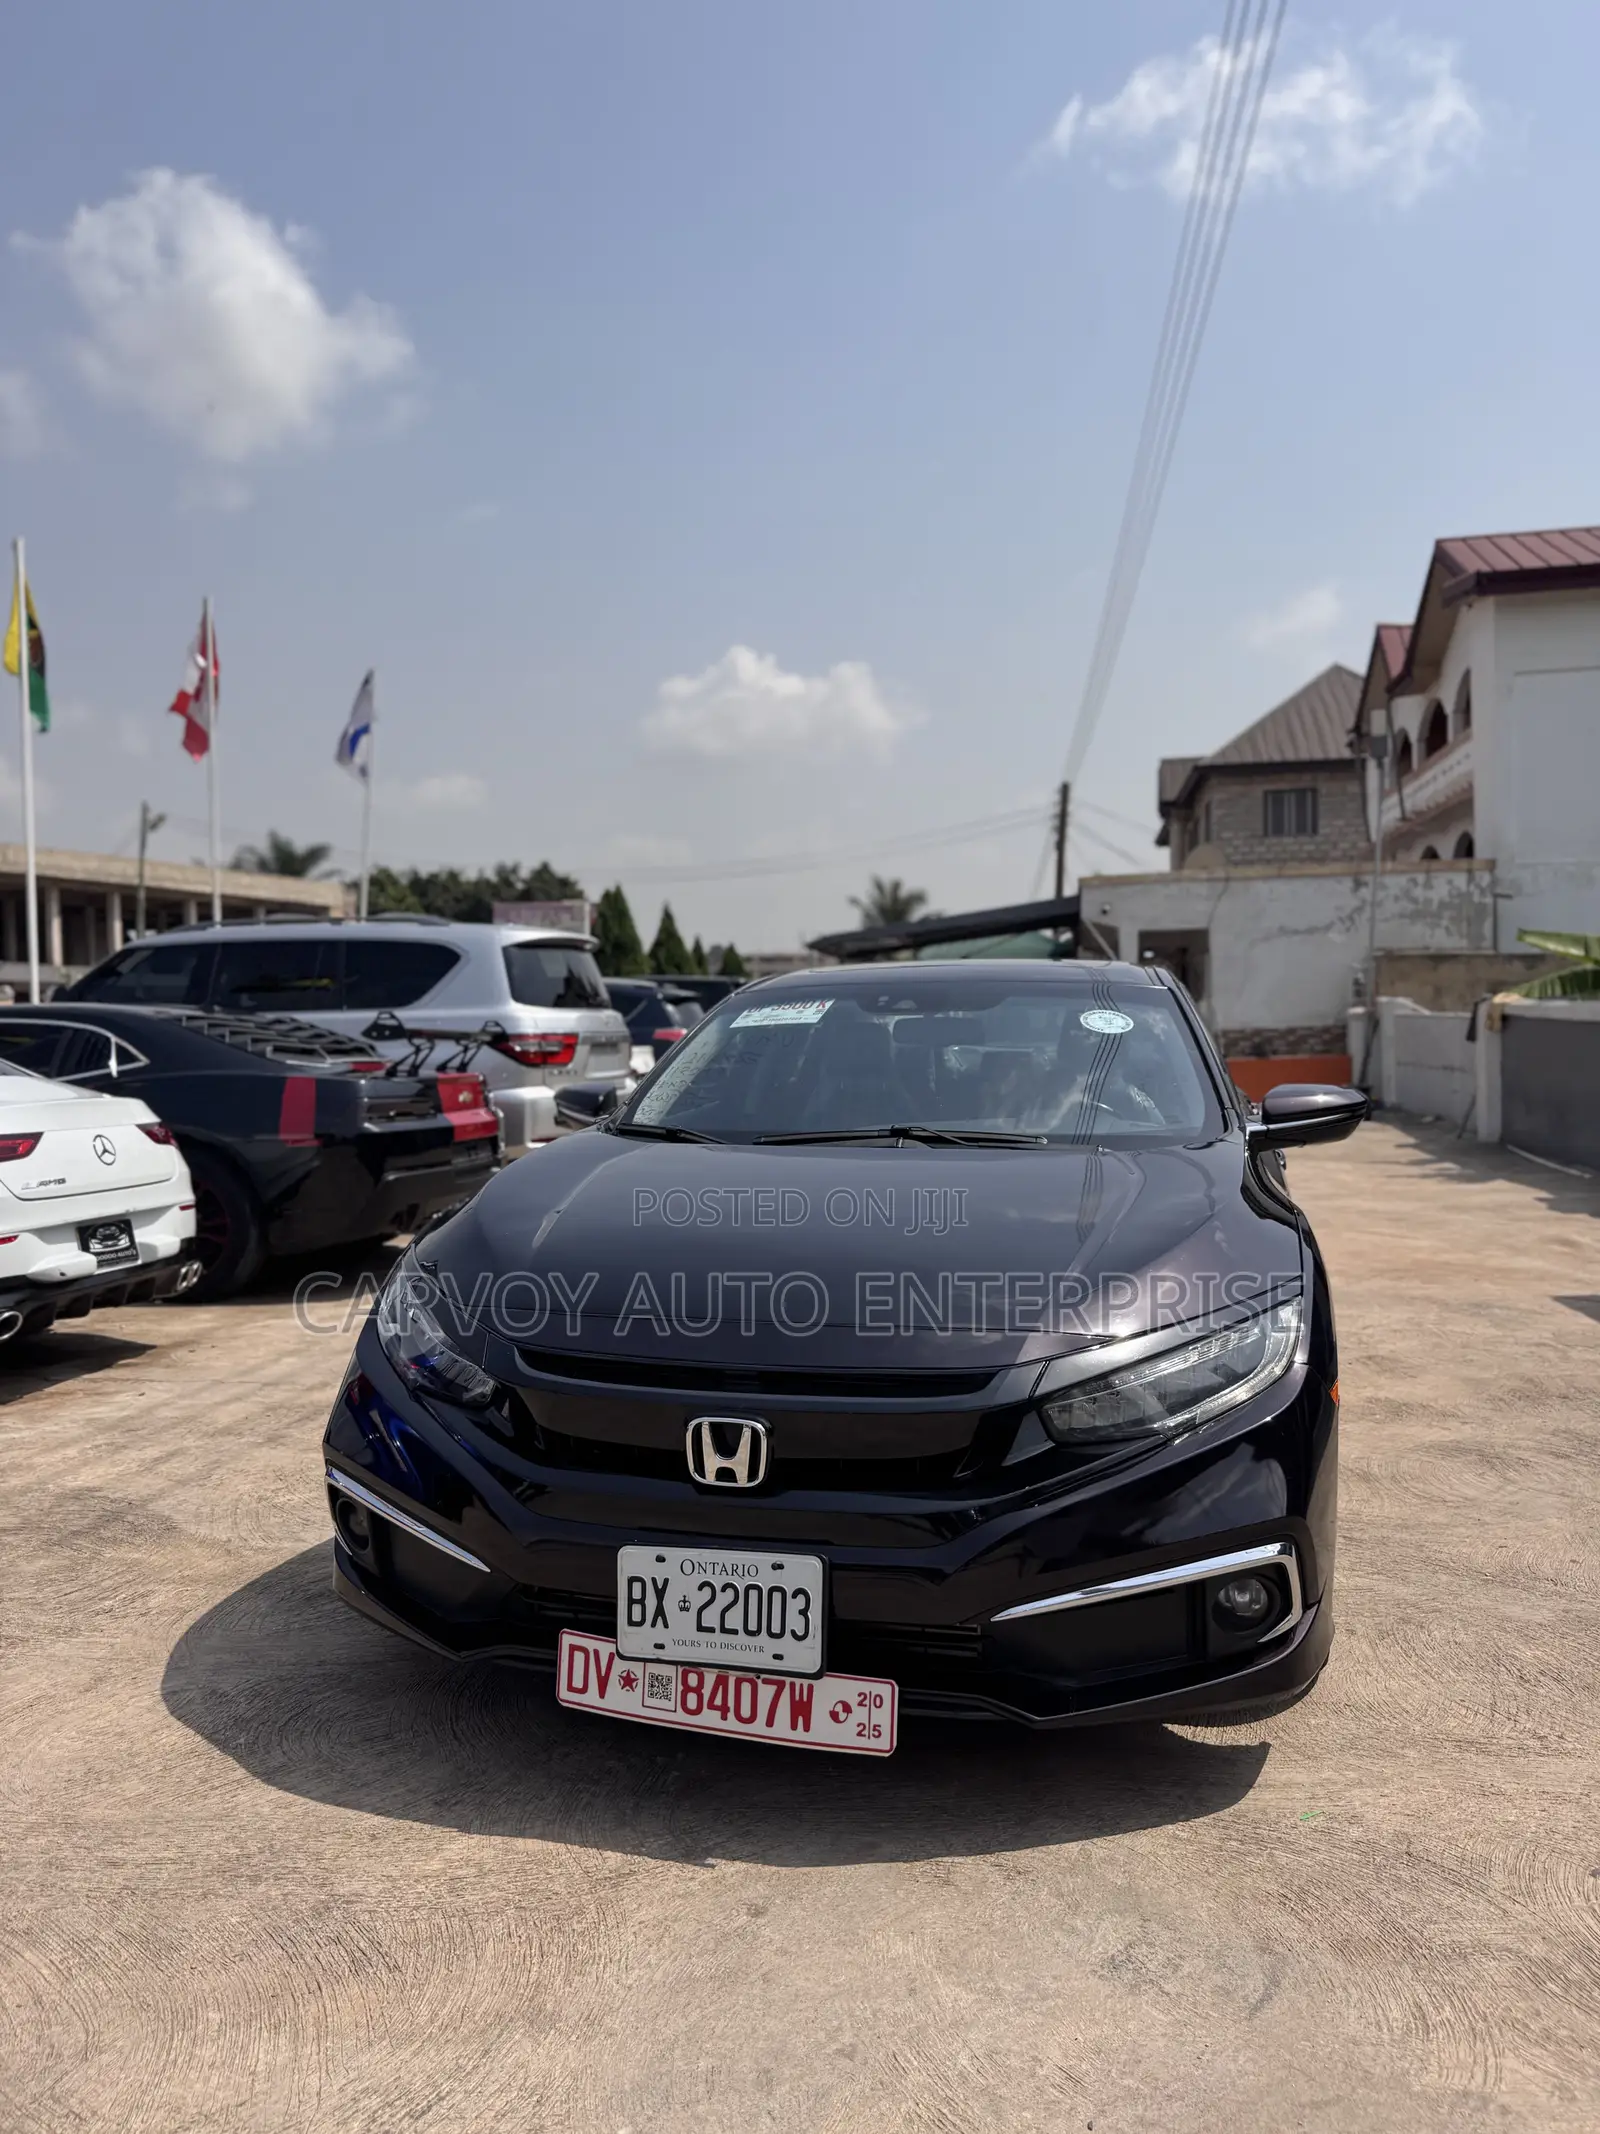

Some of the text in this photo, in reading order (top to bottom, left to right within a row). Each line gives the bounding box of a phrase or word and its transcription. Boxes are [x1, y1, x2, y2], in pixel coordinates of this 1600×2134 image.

[679, 1558, 760, 1579] ONTARIO
[626, 1575, 811, 1642] BX 22003
[671, 1637, 765, 1654] YOURS TO DISCOVER
[566, 1643, 815, 1733] DV 8407W
